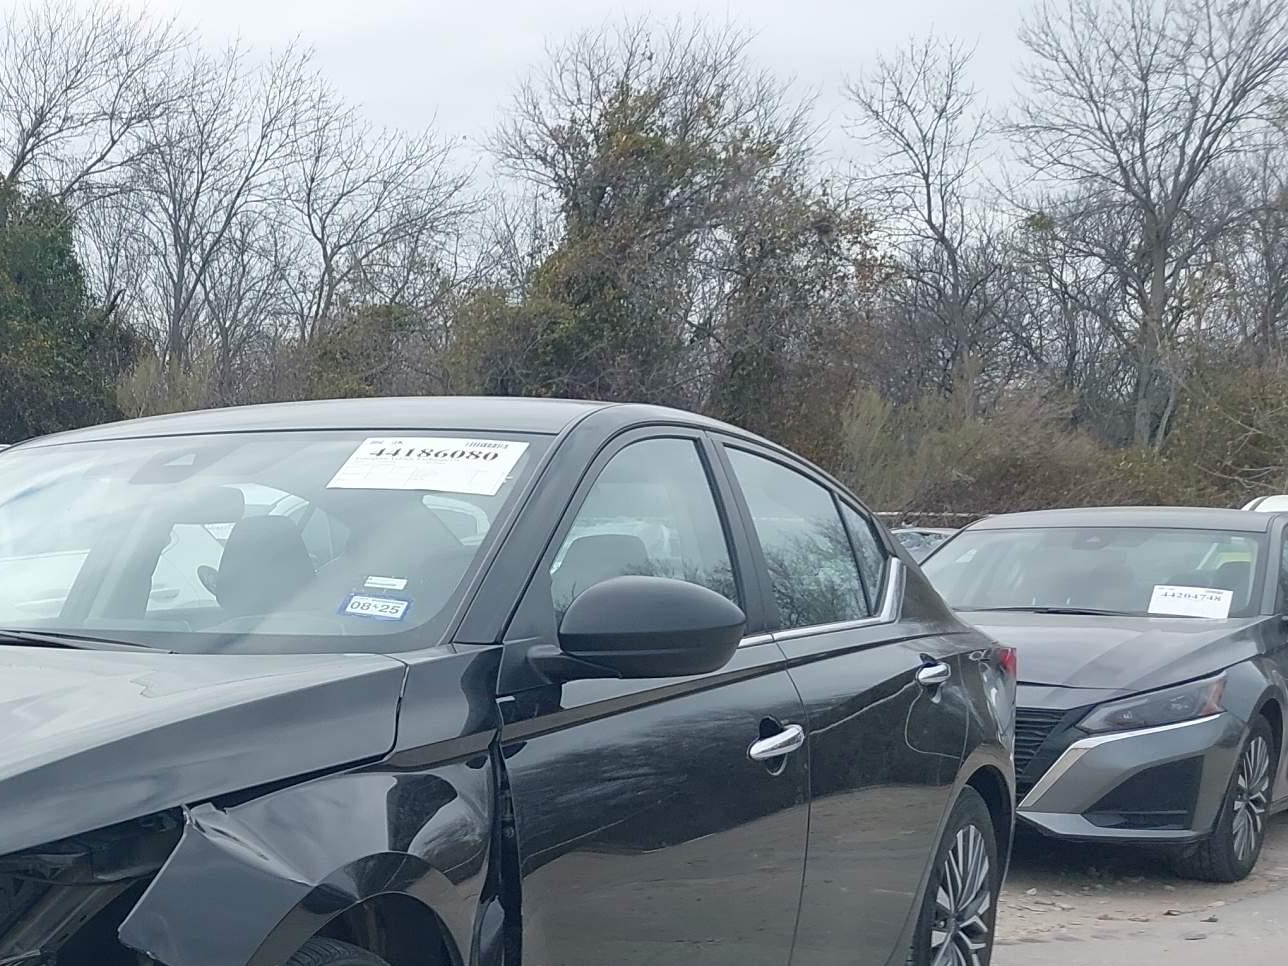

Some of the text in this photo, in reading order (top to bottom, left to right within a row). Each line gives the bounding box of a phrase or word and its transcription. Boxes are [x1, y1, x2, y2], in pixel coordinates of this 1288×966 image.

[369, 447, 499, 461] 44186080
[350, 600, 372, 611] 08
[378, 604, 401, 615] 25
